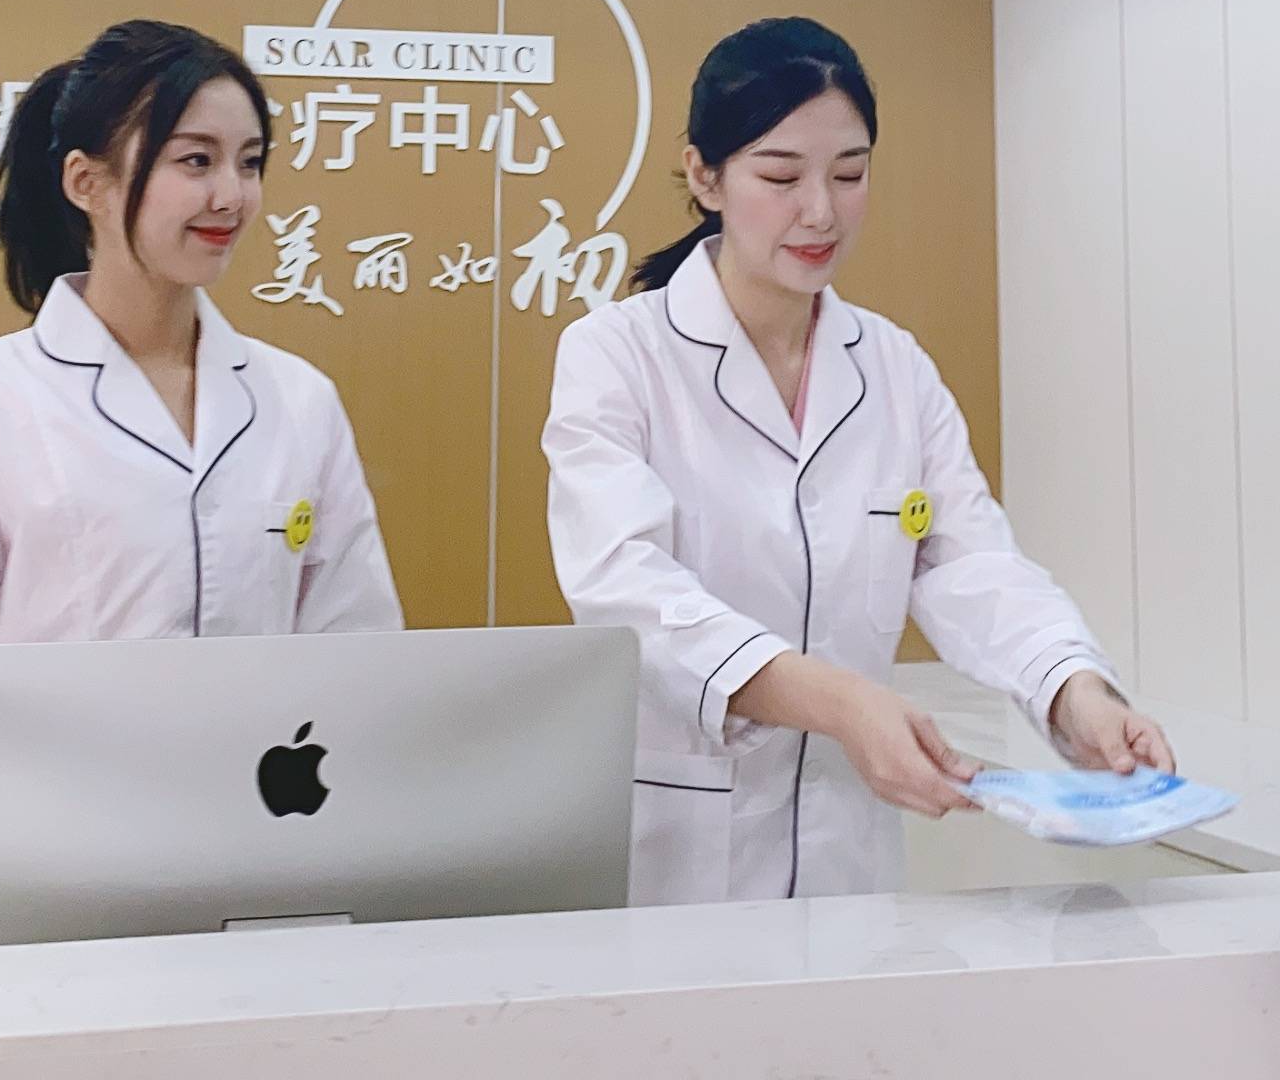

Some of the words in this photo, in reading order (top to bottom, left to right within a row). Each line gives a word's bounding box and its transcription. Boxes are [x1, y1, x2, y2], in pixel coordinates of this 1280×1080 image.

[264, 37, 374, 69] SCAR
[393, 41, 537, 74] CLINIC
[267, 84, 566, 176] 疗中心
[250, 199, 629, 317] 美丽如初
